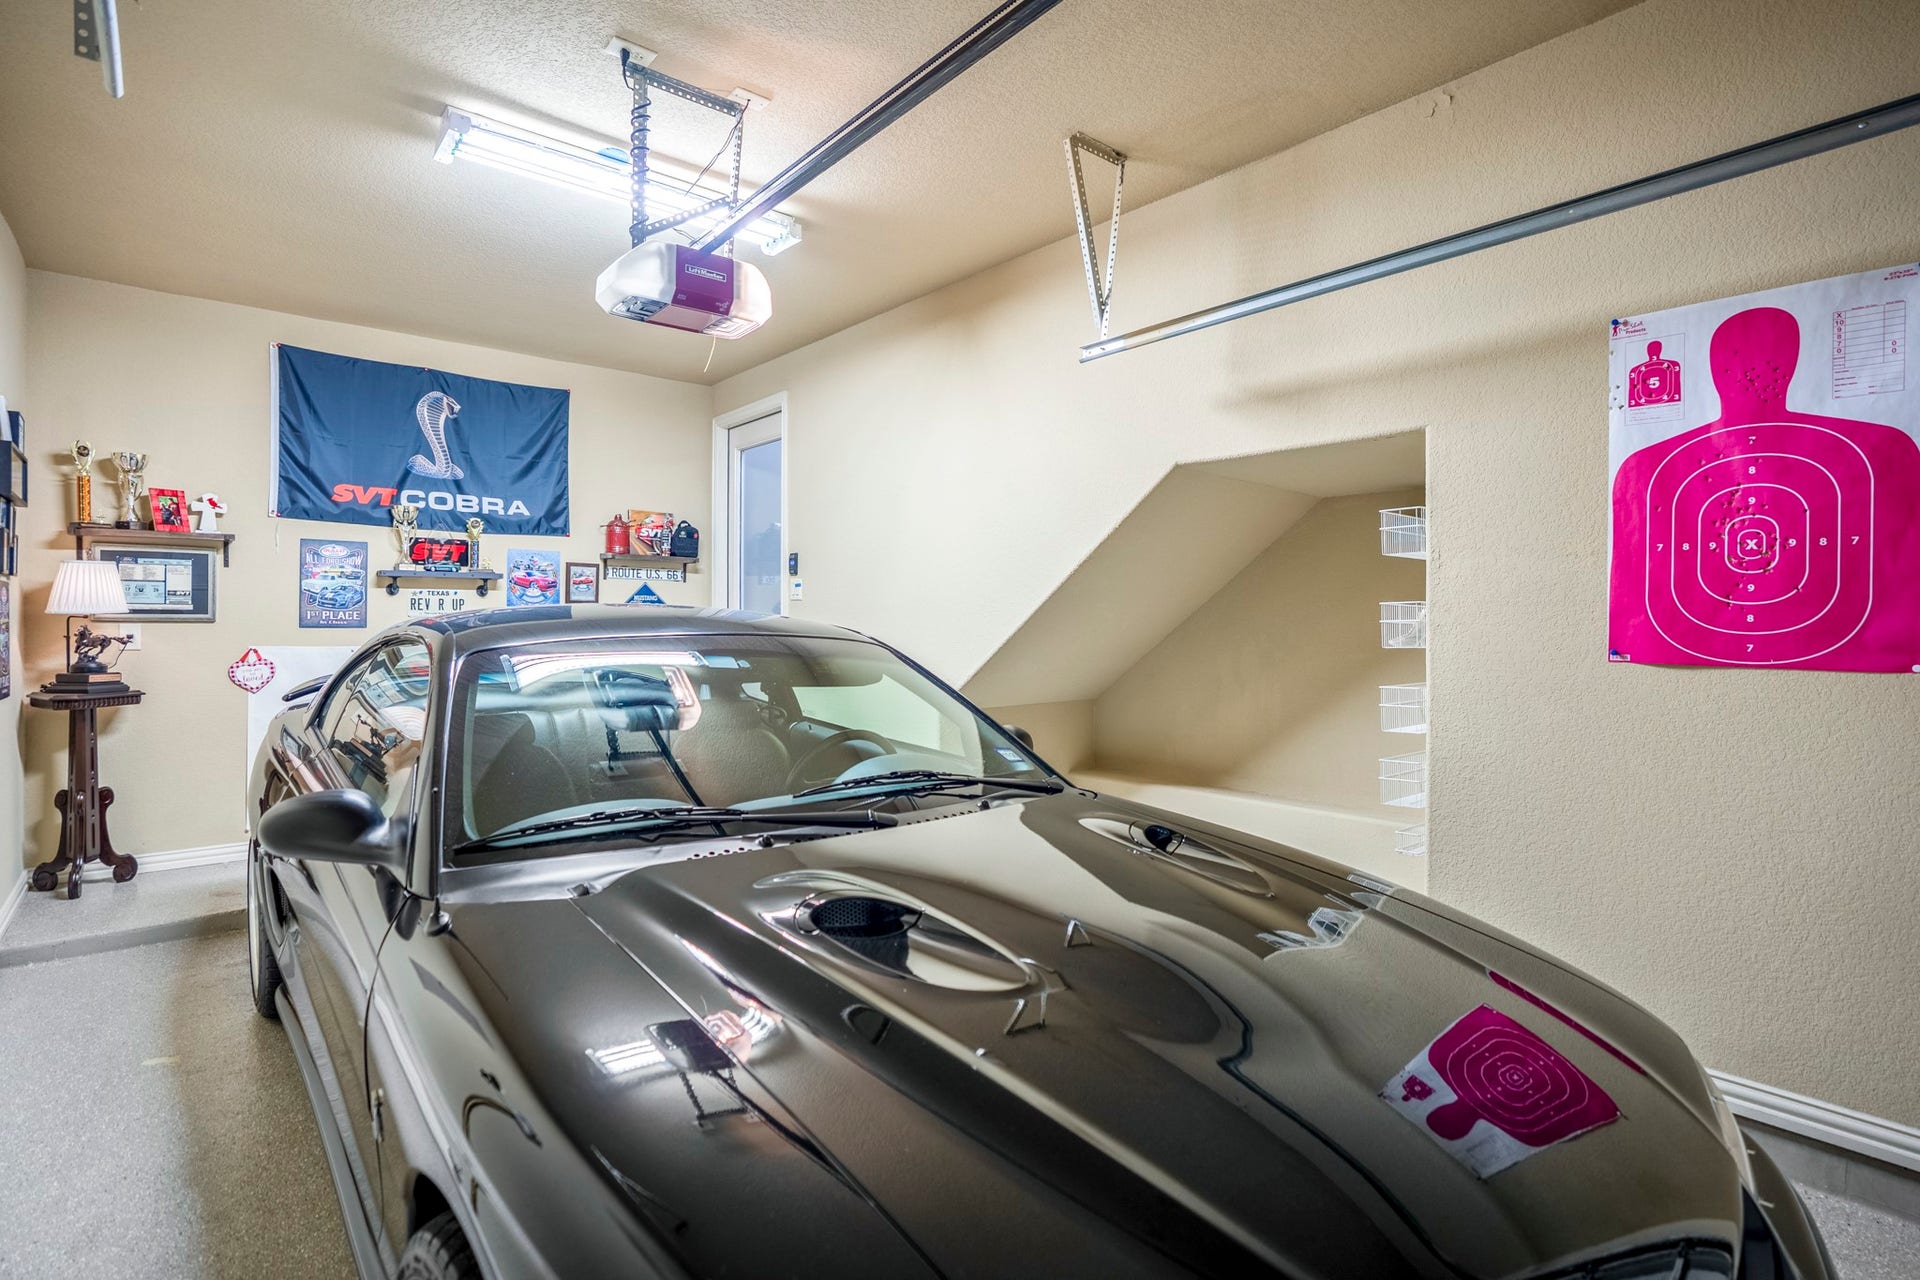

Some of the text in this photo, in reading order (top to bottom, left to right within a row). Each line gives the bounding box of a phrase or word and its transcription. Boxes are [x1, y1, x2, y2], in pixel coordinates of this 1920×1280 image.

[688, 266, 724, 279] LiftMaster
[1649, 377, 1660, 388] 5
[1748, 466, 1756, 474] 8
[331, 483, 530, 516] SVT COBRA
[1748, 496, 1756, 504] 9
[1709, 542, 1717, 550] 9
[1745, 539, 1758, 550] X
[1788, 538, 1796, 547] 9
[1819, 537, 1828, 546] 8
[1851, 536, 1859, 545] 7
[411, 542, 466, 562] SVT
[305, 552, 320, 564] ALL
[342, 554, 362, 566] SHOW
[611, 567, 679, 580] ROUTE U.S. 66
[1747, 584, 1755, 592] 9
[410, 597, 465, 611] REV R UP
[322, 610, 361, 620] PLACE
[1746, 614, 1754, 622] 8
[1746, 644, 1754, 652] 7
